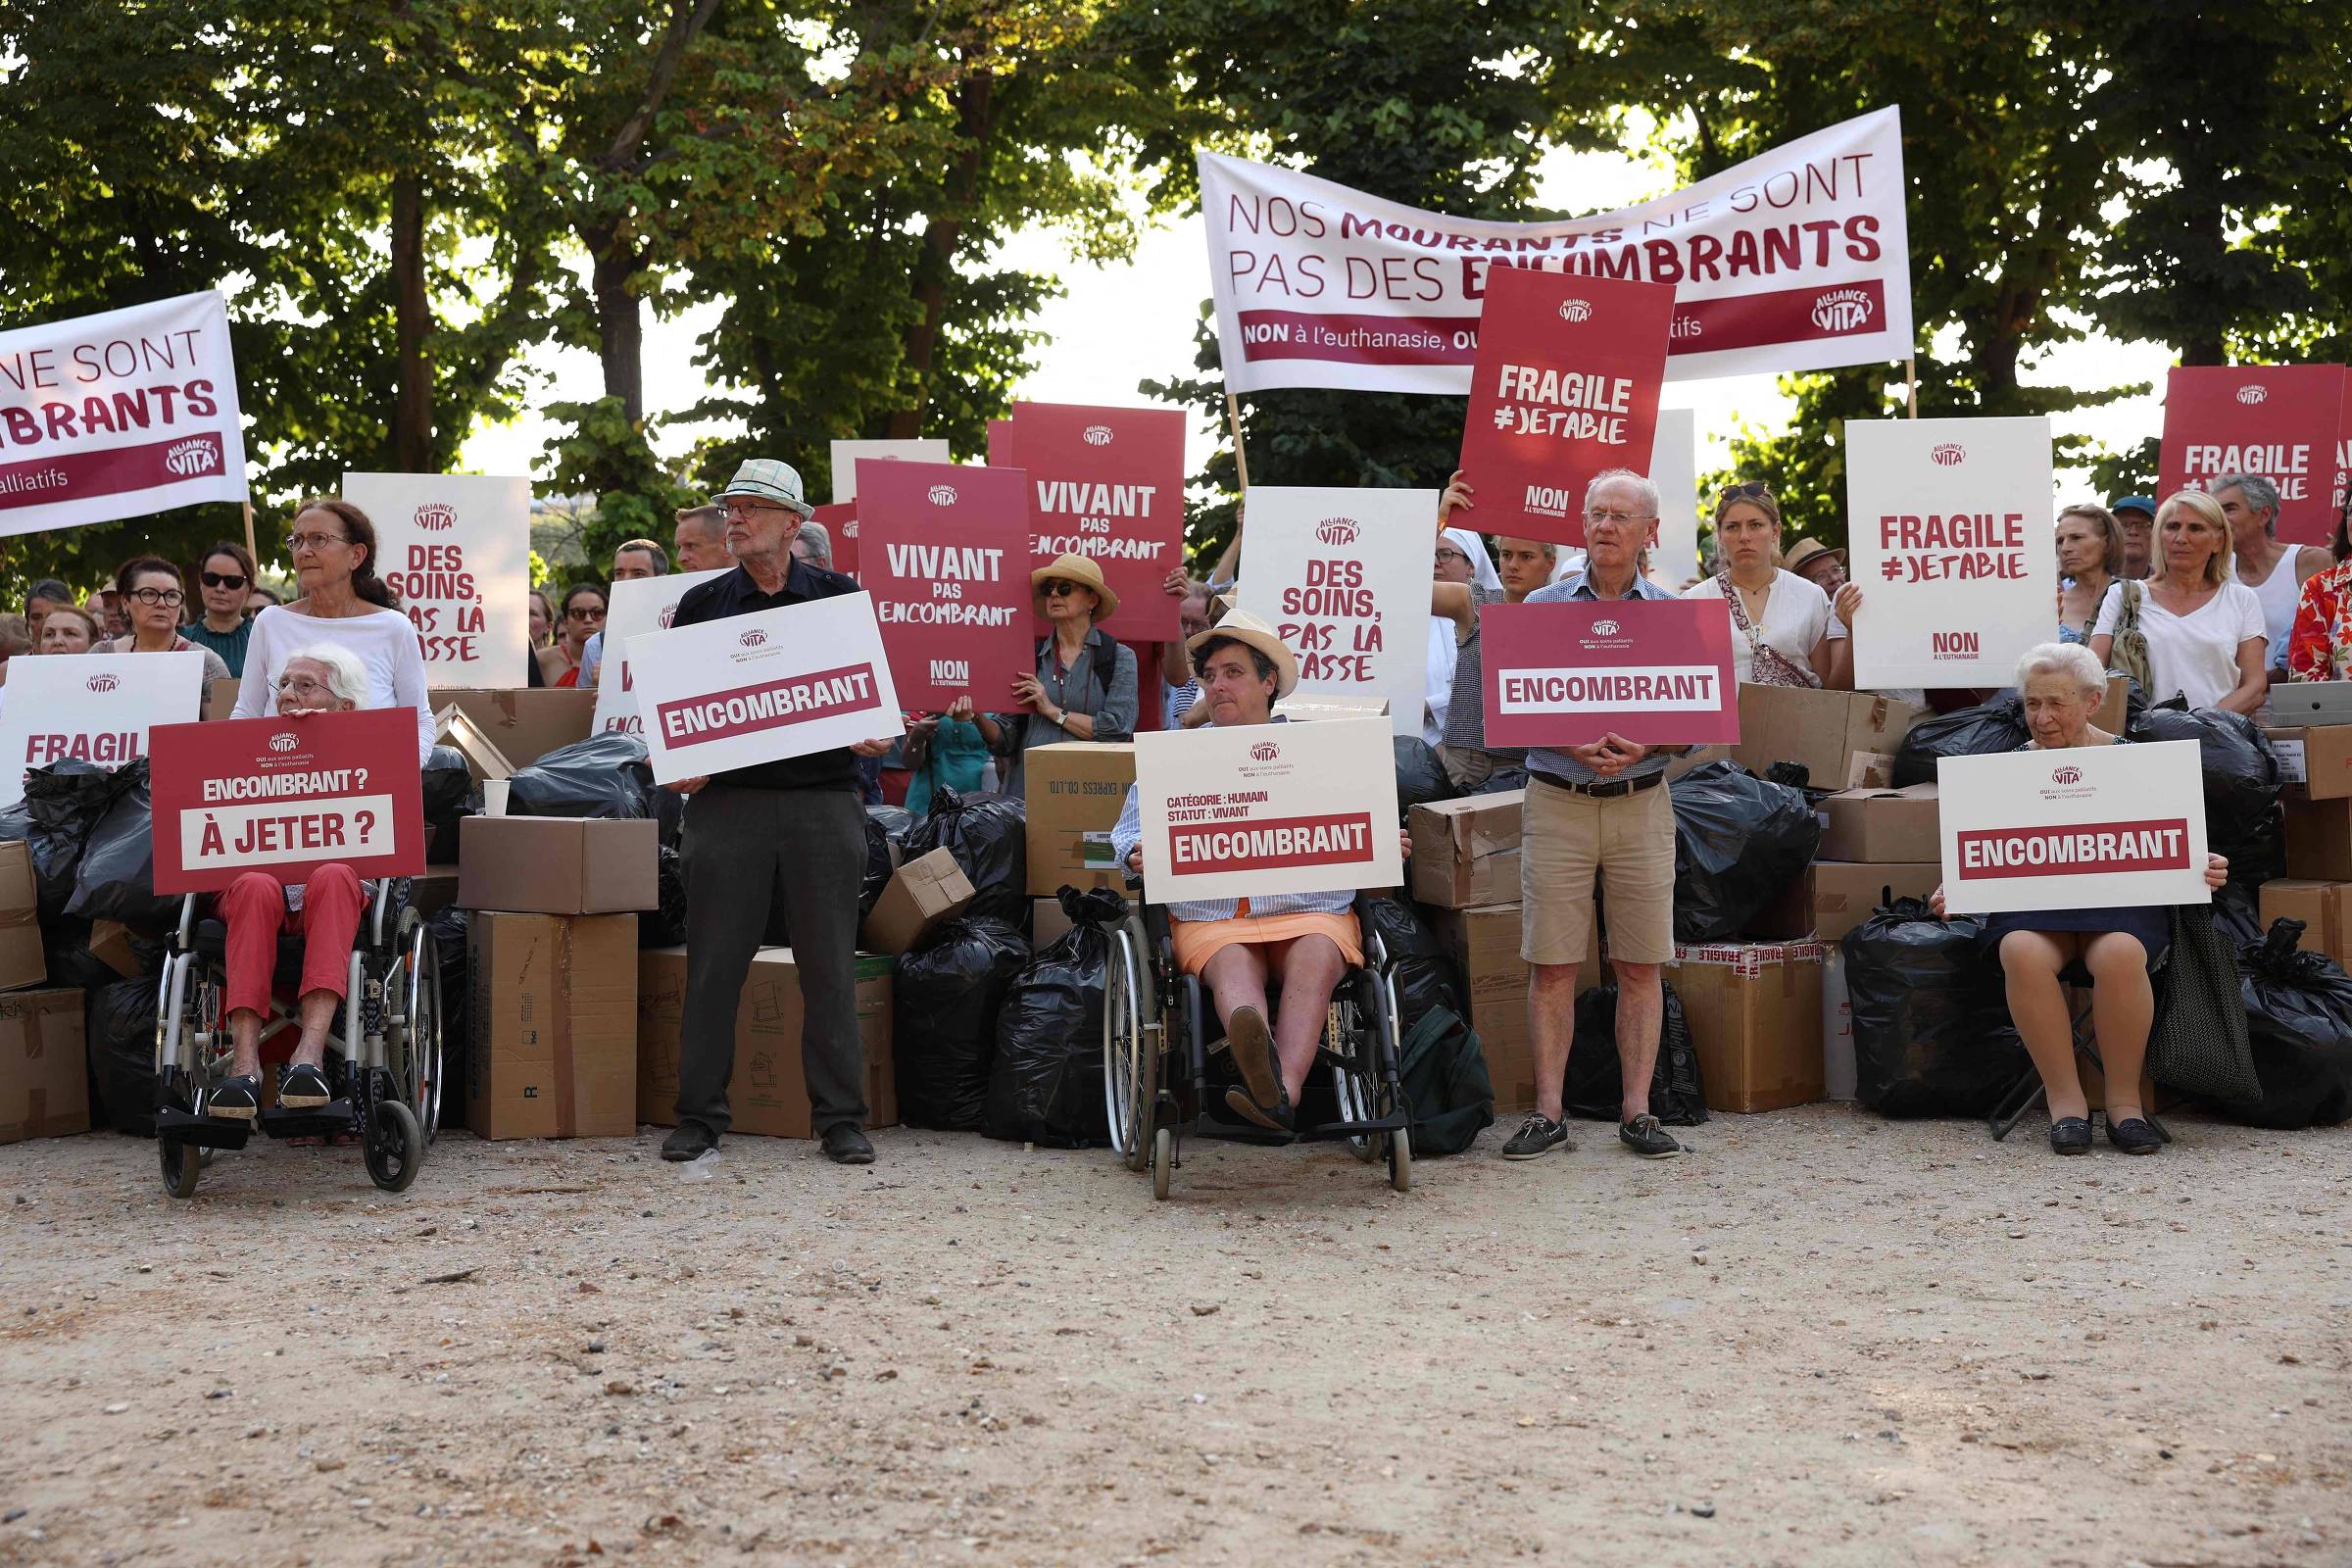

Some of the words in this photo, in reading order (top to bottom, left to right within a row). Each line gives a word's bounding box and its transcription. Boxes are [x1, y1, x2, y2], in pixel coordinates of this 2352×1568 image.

[1230, 194, 1325, 238] NOS
[1341, 212, 1623, 252] MOURANTS
[1644, 201, 1709, 234] NE
[1731, 153, 1873, 212] SONT
[1230, 250, 1325, 297] PAS
[1346, 257, 1444, 301] DES
[1460, 215, 1881, 300] EOMBRANTS
[1562, 298, 1592, 309] ALLIANCE
[1816, 289, 1868, 309] ALLIANCE
[1563, 306, 1588, 322] VITA
[1818, 302, 1867, 331] VITA
[1245, 323, 1289, 344] NON
[1296, 325, 1307, 343] à
[73, 329, 201, 382] SONT
[1497, 364, 1633, 415] FRAGILE
[2239, 391, 2264, 405] VITA
[0, 379, 218, 448] BRANTS
[168, 438, 214, 460] ALLIANCE
[1087, 431, 1110, 446] VITA
[1934, 443, 1963, 453] ALLIANCE
[172, 450, 216, 475] VITA
[1935, 451, 1962, 466] VITA
[2184, 444, 2310, 474] FRAGILE
[417, 503, 454, 514] ALLIANCE
[931, 491, 955, 506] VITA
[1037, 480, 1155, 517] VIVANT
[1525, 485, 1569, 511] NON
[418, 512, 453, 530] VITA
[1080, 517, 1110, 534] PAS
[1319, 516, 1357, 528] ALLIANCE
[1320, 525, 1355, 546] VITA
[1881, 514, 2024, 550] FRAGILE
[408, 545, 463, 571] DES
[886, 543, 1004, 581] VIVANT
[1305, 559, 1363, 588] DES
[386, 571, 482, 604] SOINS,
[932, 582, 962, 600] PAS
[879, 601, 1017, 627] ENCOMBRANT
[1282, 587, 1382, 622] SOINS,
[408, 605, 440, 632] AS
[458, 606, 485, 633] LA
[1594, 624, 1616, 635] VITA
[742, 634, 765, 647] VITA
[1277, 621, 1337, 651] PAS
[1352, 623, 1383, 652] LA
[1933, 632, 1979, 653] NON
[930, 660, 969, 679] NON
[90, 679, 116, 693] VITA
[1505, 674, 1713, 704] ENCOMBRANT
[664, 671, 870, 738] ENCOMBRANT
[25, 732, 145, 763] FRAGIL
[272, 739, 296, 752] VITA
[1253, 748, 1277, 761] VITA
[203, 769, 351, 802] ENCOMBRANT
[1083, 781, 1117, 796] EXPRESS
[2055, 772, 2080, 784] VITA
[1166, 793, 1222, 808] CATÉGORIE
[1228, 791, 1268, 806] HUMAIN
[1167, 808, 1206, 822] STATUT
[1212, 806, 1250, 819] VIVANT
[200, 813, 225, 857] À
[234, 812, 346, 854] JETER
[1175, 822, 1367, 863] ENCOMBRANT
[1964, 829, 2182, 868] ENCOMBRANT
[1698, 948, 1741, 962] FRAGILE
